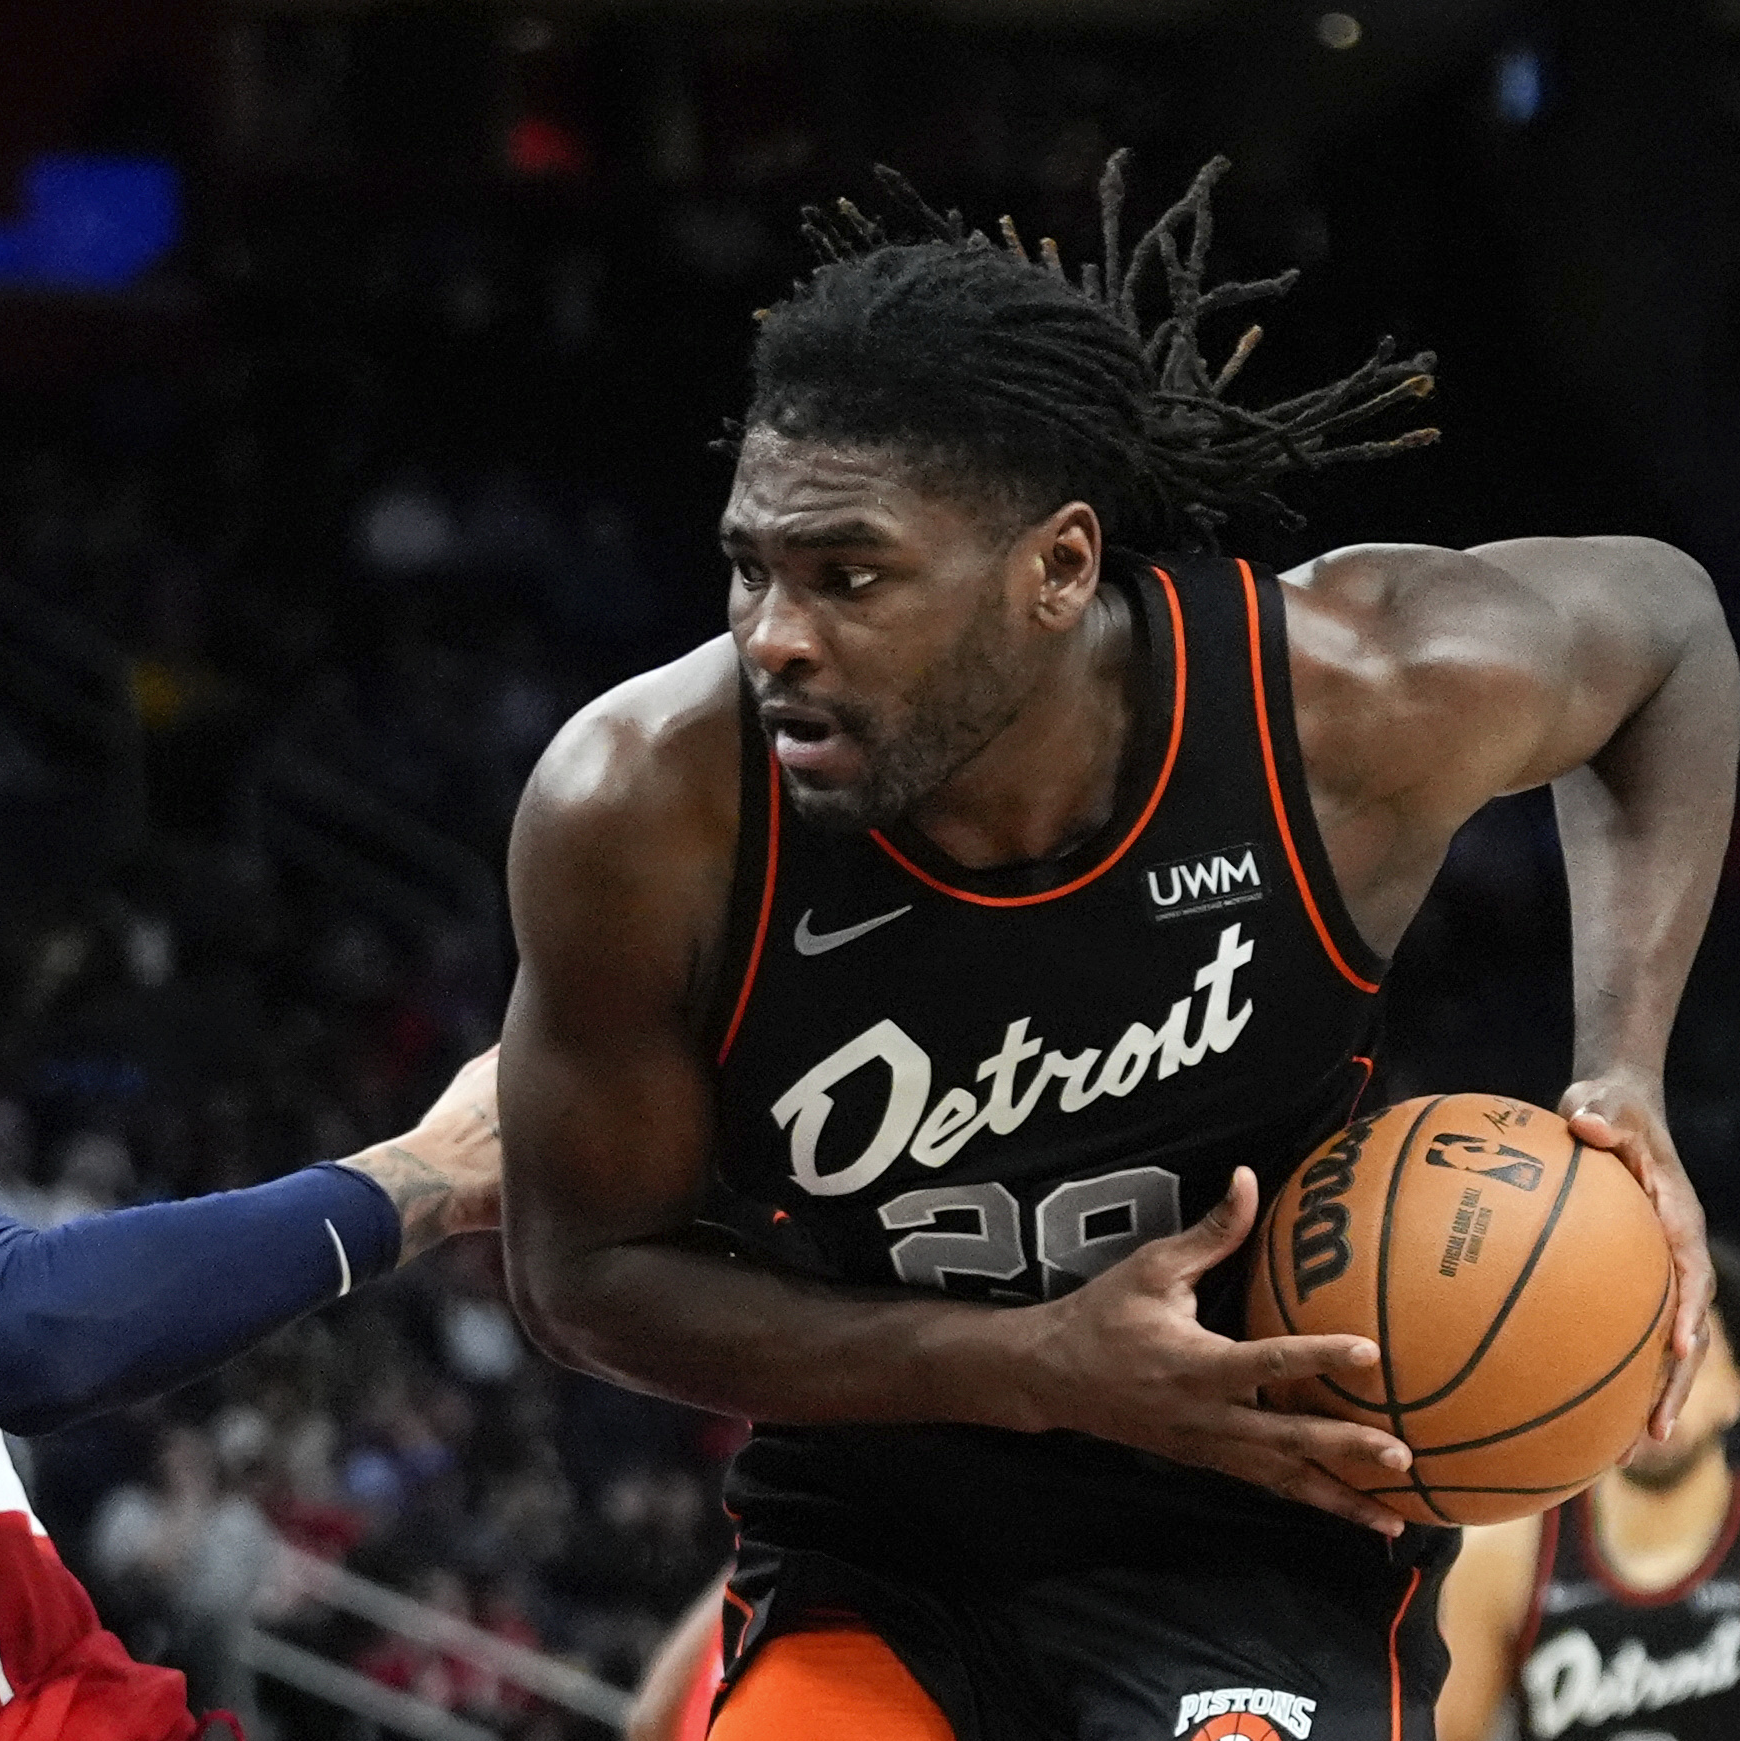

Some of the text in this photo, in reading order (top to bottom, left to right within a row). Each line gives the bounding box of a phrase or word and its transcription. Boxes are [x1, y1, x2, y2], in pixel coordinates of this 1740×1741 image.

[1147, 849, 1262, 907] UWM
[770, 921, 1256, 1197] Detroit
[1174, 1687, 1317, 1740] PISTONS
